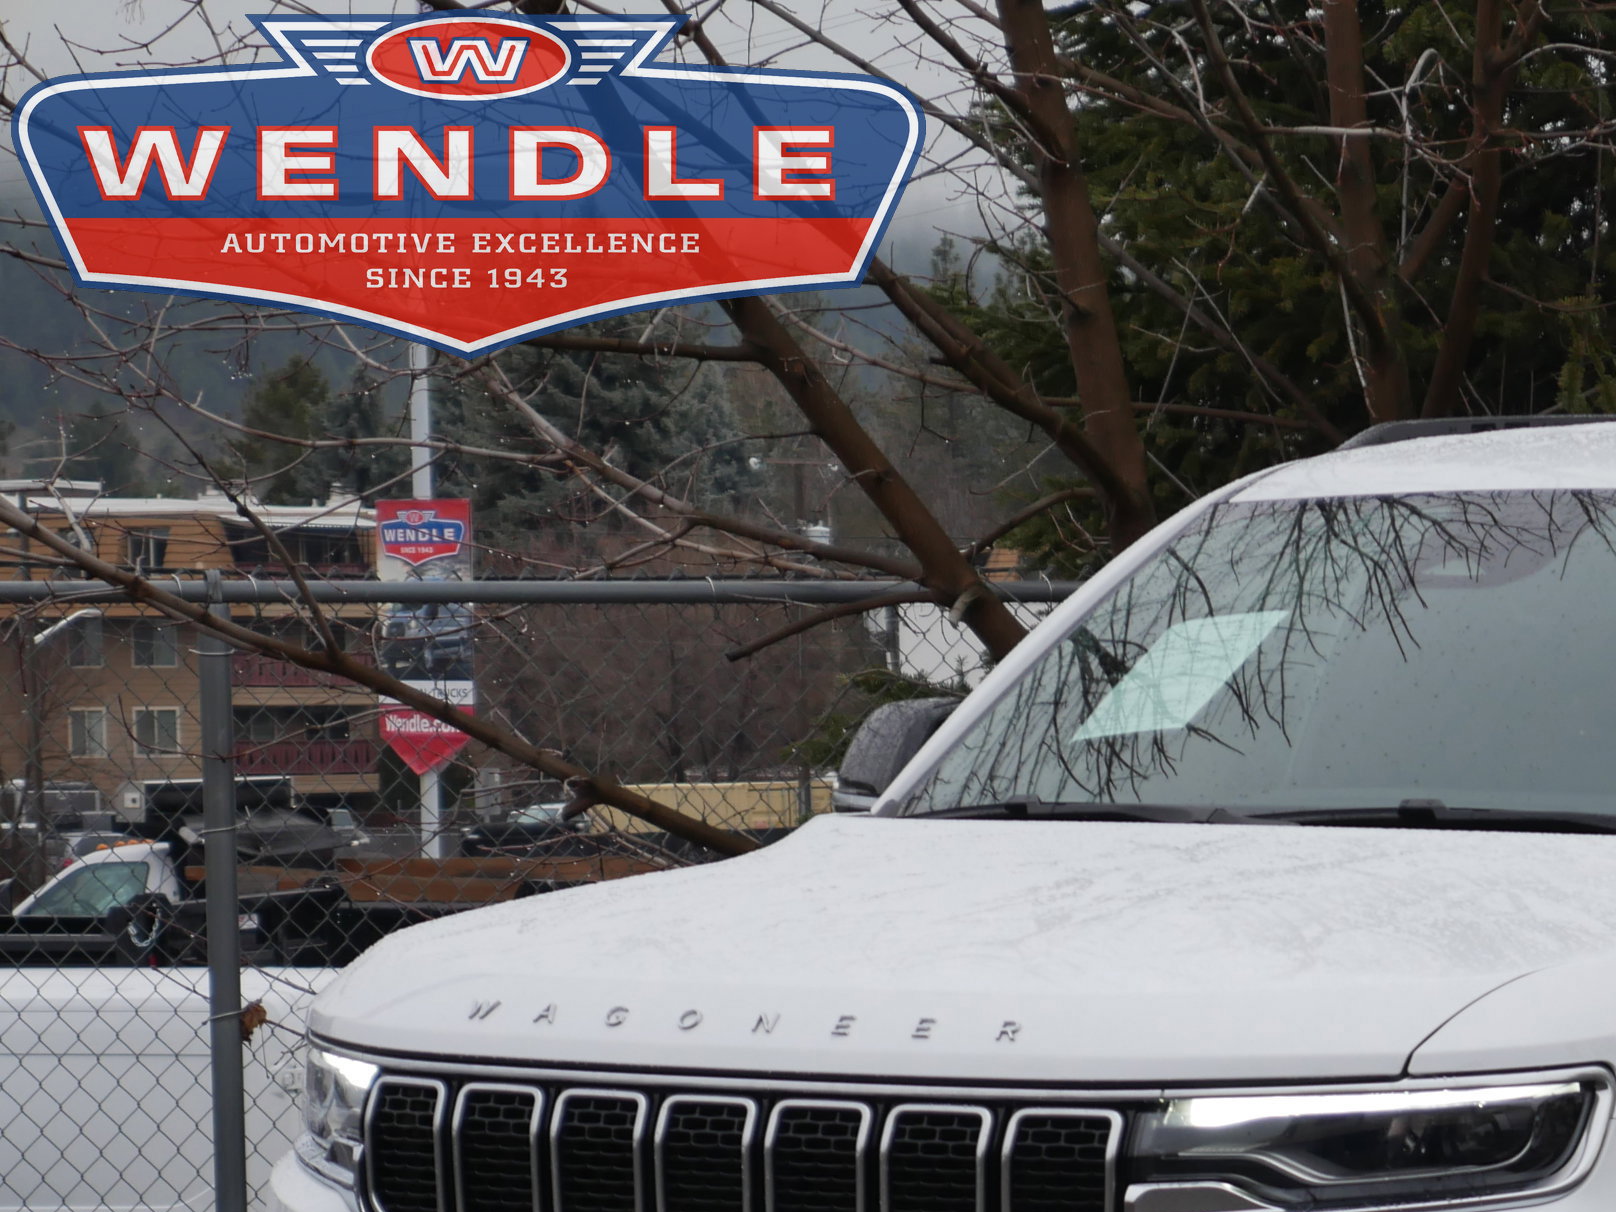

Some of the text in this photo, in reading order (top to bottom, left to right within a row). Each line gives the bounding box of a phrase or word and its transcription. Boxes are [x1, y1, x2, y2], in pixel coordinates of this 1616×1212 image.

[384, 528, 456, 542] WENDLE
[400, 546, 417, 554] SINCE
[468, 998, 1021, 1042] WAGONEER
